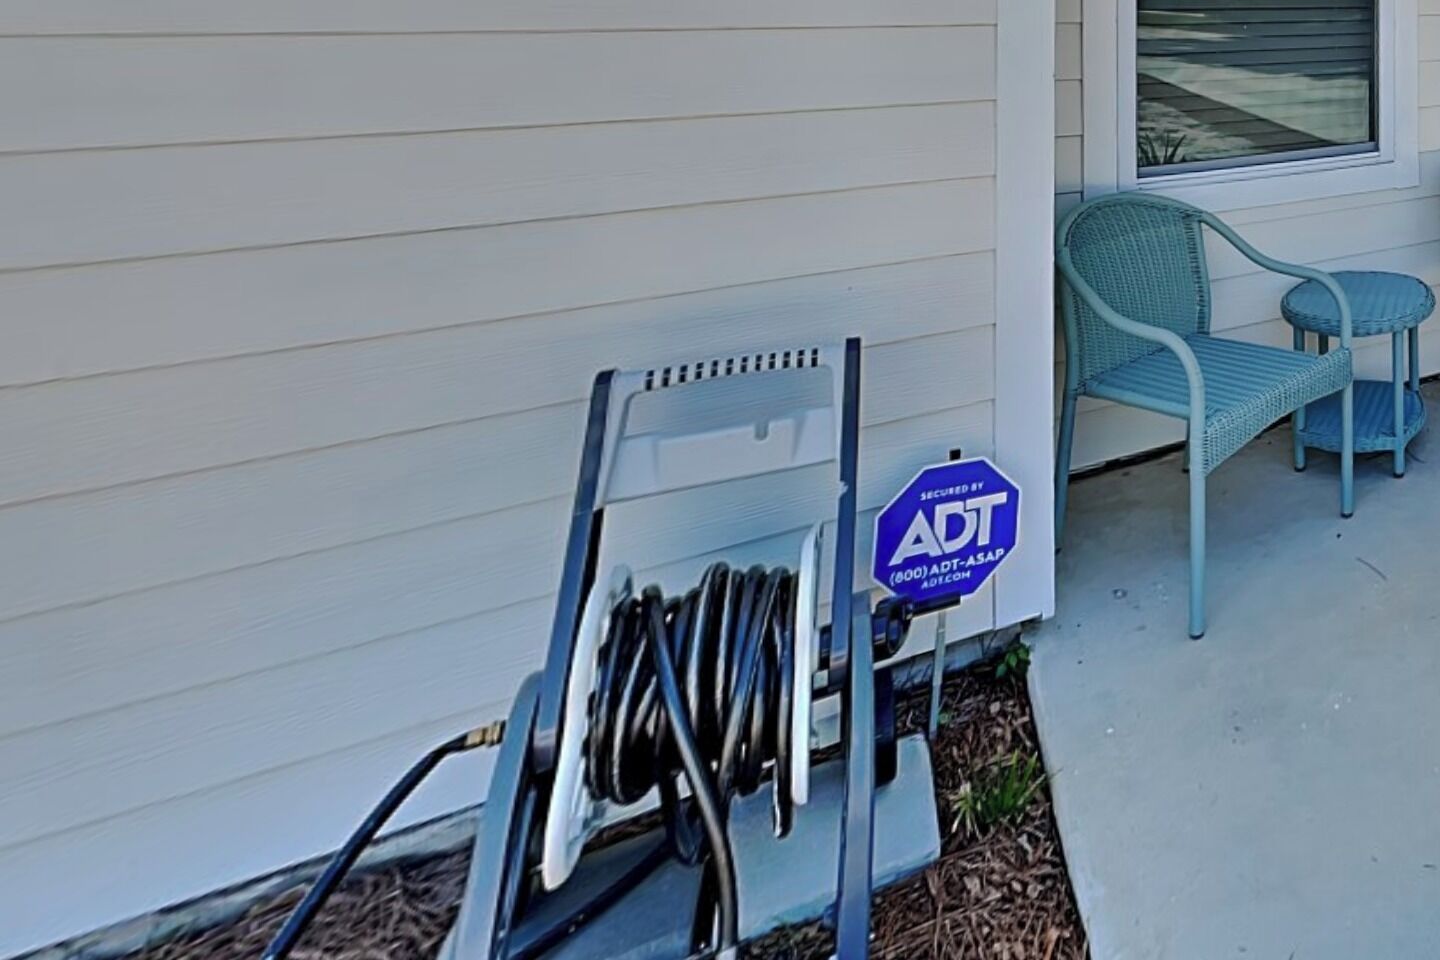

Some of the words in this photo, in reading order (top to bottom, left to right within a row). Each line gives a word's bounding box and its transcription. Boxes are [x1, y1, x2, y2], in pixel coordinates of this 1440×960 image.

[920, 485, 968, 500] SECURED
[970, 481, 984, 492] BY
[888, 492, 1008, 566] ADT
[889, 565, 927, 587] (800)
[929, 548, 1005, 574] ADT-ASAP
[921, 570, 971, 589] ADT.COM
